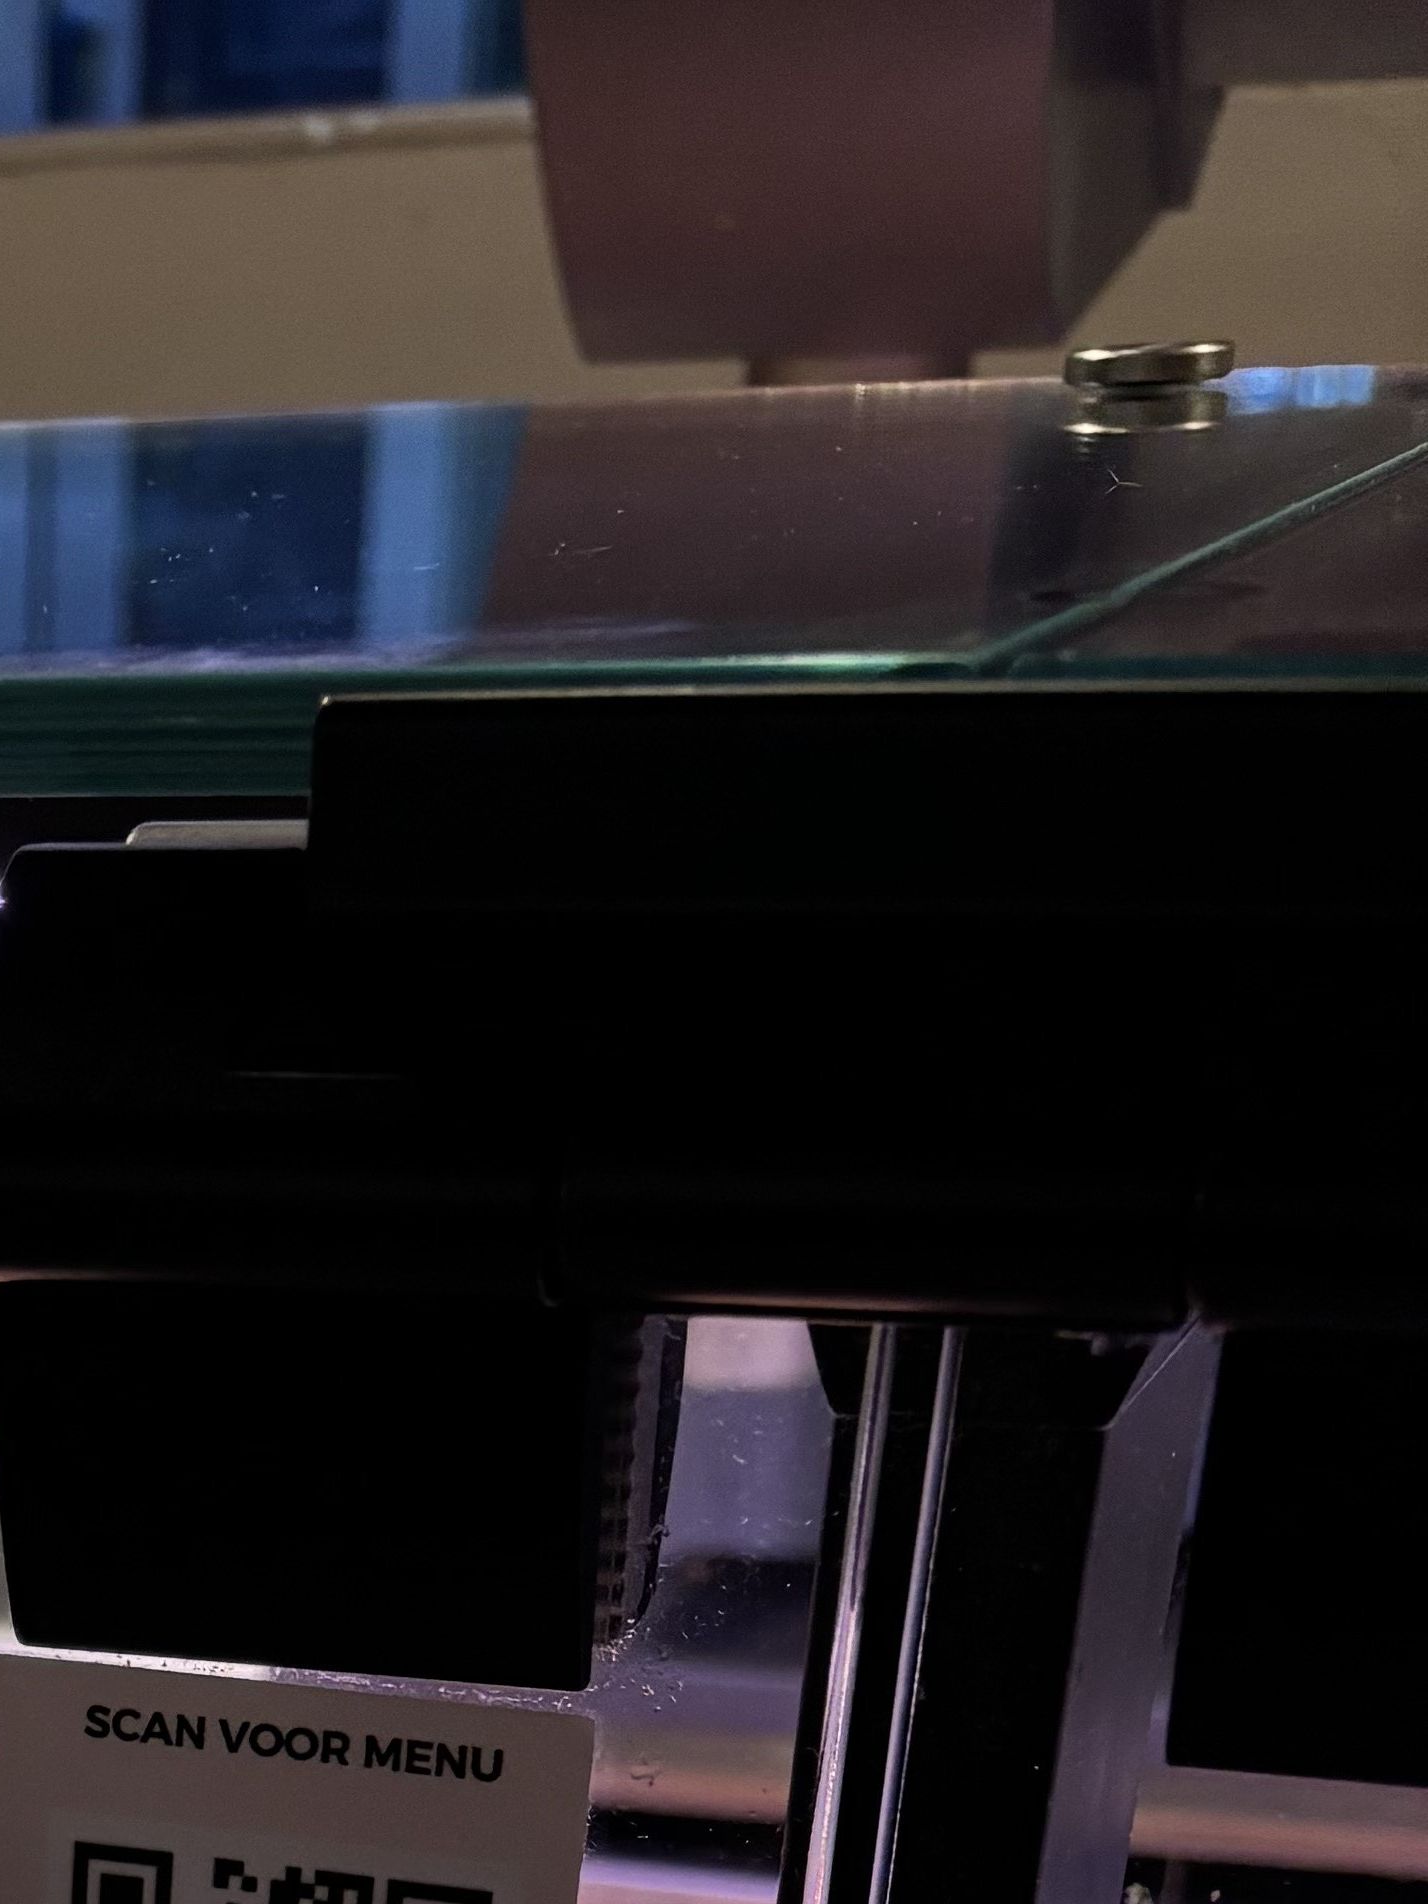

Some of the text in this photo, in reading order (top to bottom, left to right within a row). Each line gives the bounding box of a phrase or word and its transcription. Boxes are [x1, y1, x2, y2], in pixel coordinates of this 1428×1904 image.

[83, 1704, 505, 1783] SCAN VOOR MENU
